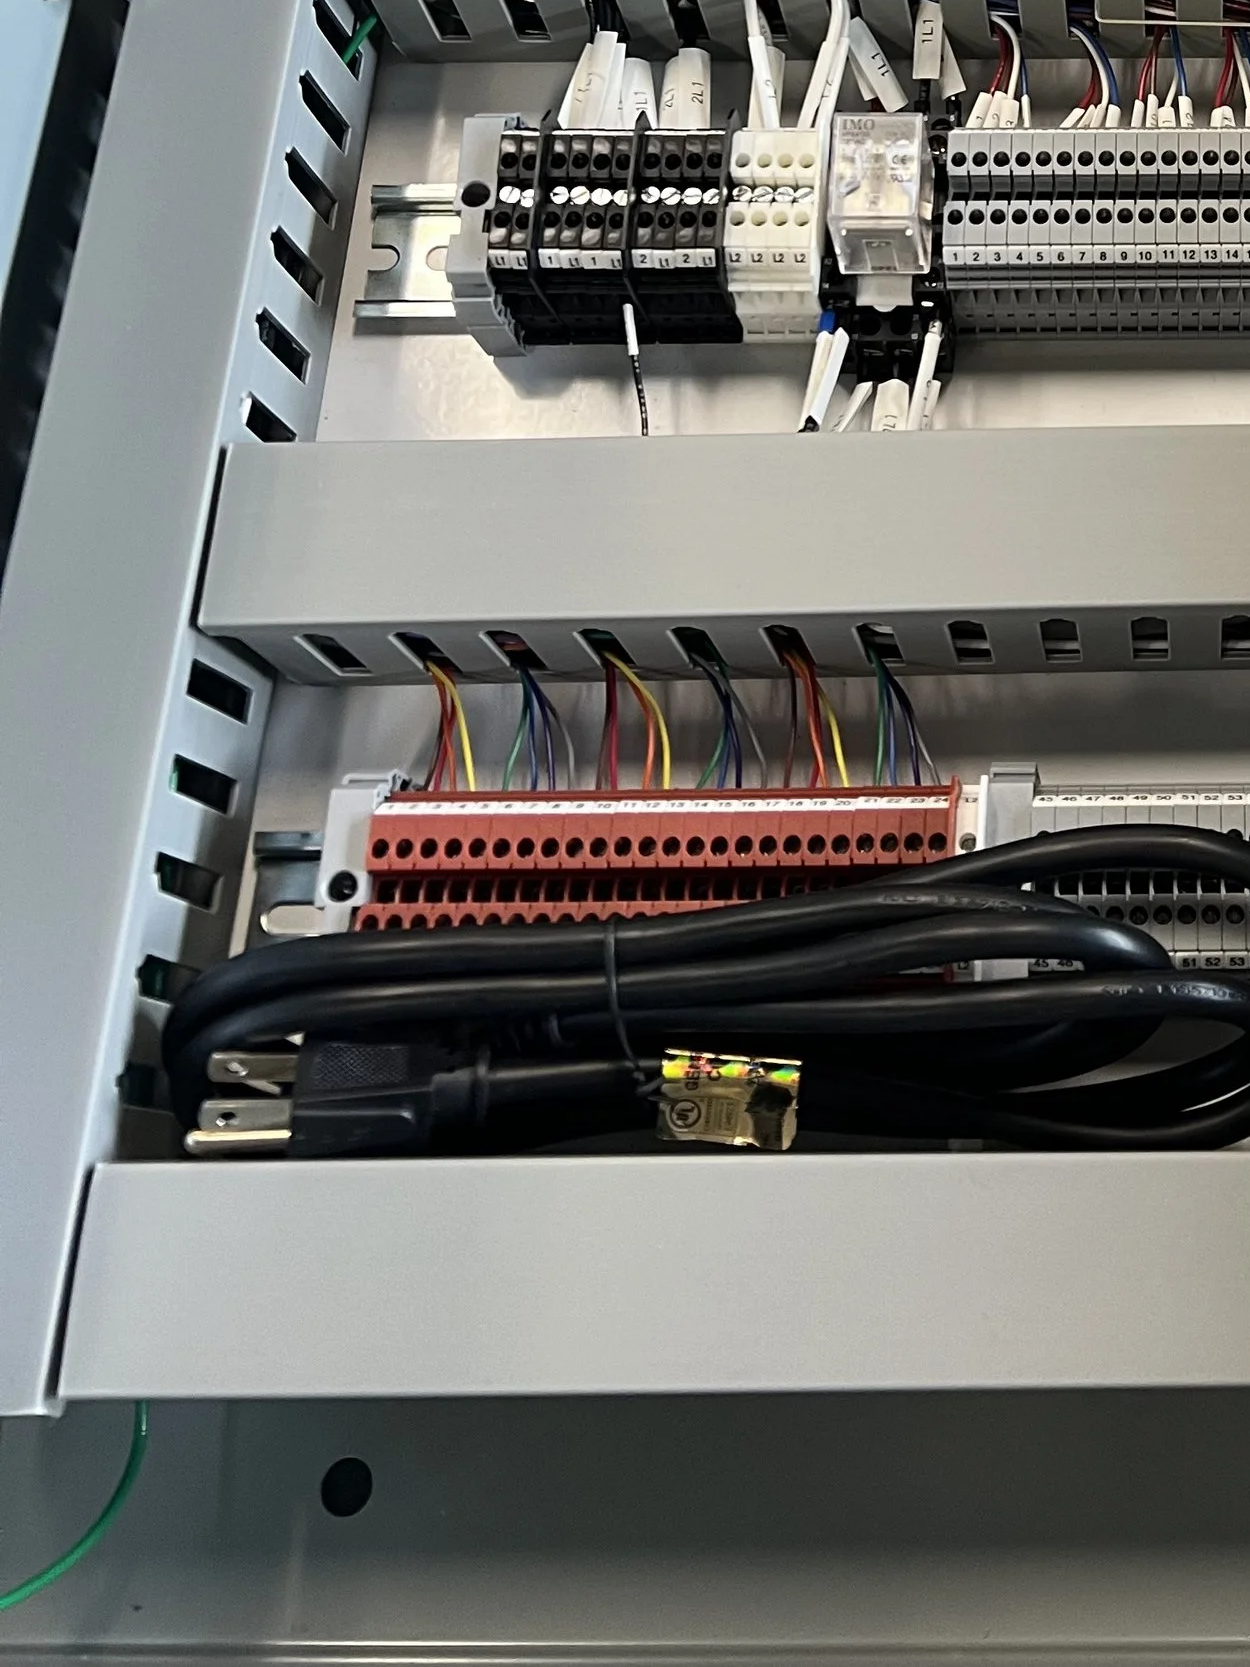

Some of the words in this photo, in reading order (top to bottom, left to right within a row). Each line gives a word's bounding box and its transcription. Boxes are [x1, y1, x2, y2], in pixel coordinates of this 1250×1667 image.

[922, 19, 935, 44] 1L1
[870, 52, 889, 77] 1L1
[691, 82, 704, 104] 2L1
[843, 118, 876, 131] IMO
[495, 256, 505, 266] L1
[516, 256, 527, 267] L1
[640, 254, 648, 264] 2
[659, 258, 670, 267] L1
[682, 254, 690, 263] 2
[702, 256, 713, 266] L1
[729, 253, 742, 263] L2
[751, 253, 763, 263] L2
[773, 253, 785, 263] L2
[794, 253, 807, 263] L2
[953, 253, 958, 261] 1
[973, 252, 980, 261] 2
[995, 252, 1002, 261] 3
[1017, 252, 1023, 260] 4
[1037, 252, 1044, 261] 5
[1058, 252, 1065, 261] 6
[1080, 252, 1086, 261] 7
[1100, 252, 1107, 261] 8
[1121, 252, 1128, 260] 9
[1139, 252, 1151, 260] 10
[1163, 250, 1174, 259] 11
[1183, 250, 1195, 259] 12
[1205, 250, 1217, 259] 13
[1226, 250, 1238, 259] 14
[547, 256, 553, 265] 1
[568, 258, 579, 267] L1
[591, 256, 597, 265] 1
[610, 258, 621, 268] L1
[1182, 958, 1196, 967] 51
[1204, 957, 1220, 967] 52
[1229, 957, 1245, 967] 53
